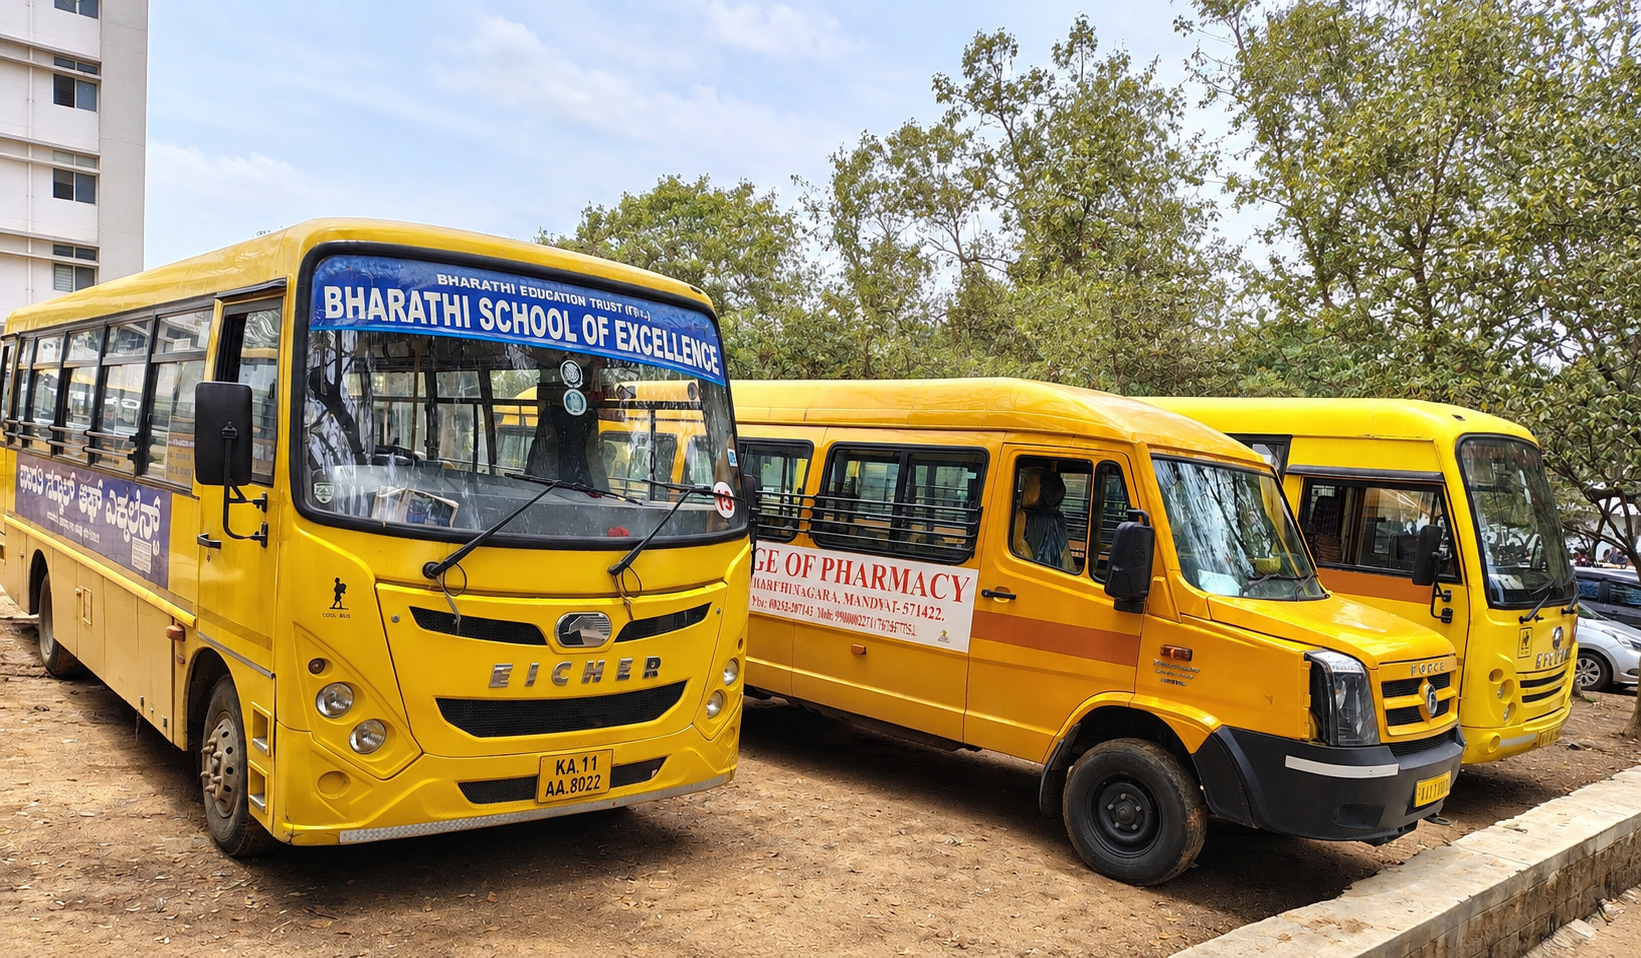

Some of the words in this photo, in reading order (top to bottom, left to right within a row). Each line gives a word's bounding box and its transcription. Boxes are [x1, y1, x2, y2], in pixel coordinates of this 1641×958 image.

[436, 273, 516, 295] BHARATHI
[520, 286, 586, 306] EDUCATION
[589, 298, 623, 313] TRUST
[324, 286, 471, 329] BHARATHI
[478, 297, 578, 343] SCHOOL
[582, 314, 609, 347] OF
[614, 319, 720, 376] EXCELLENCE
[785, 552, 817, 579] OF
[820, 556, 971, 603] PHARMACY
[489, 656, 662, 688] EICHER
[555, 755, 597, 776] KA.11
[545, 774, 601, 797] AA.8022
